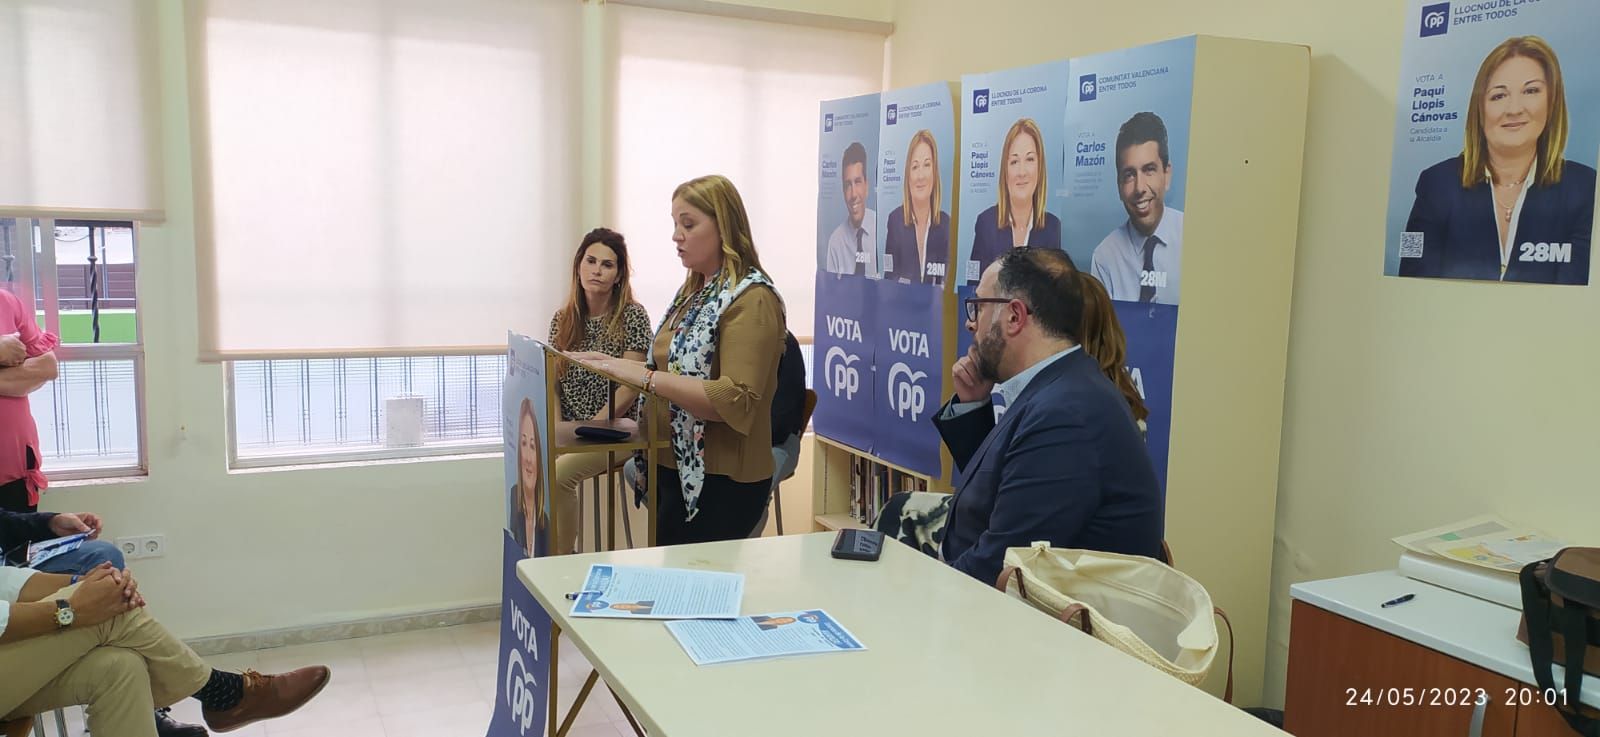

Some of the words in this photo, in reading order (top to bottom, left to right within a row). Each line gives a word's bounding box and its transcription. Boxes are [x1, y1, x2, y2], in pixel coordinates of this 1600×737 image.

[1455, 1, 1497, 15] LLOCNOU
[1454, 14, 1483, 25] ENTRE
[1485, 8, 1518, 20] TODOS
[1098, 72, 1130, 84] COMUNITAT
[1413, 85, 1445, 98] Paqui
[1412, 98, 1445, 111] Llopis
[1411, 112, 1458, 123] Cánovas
[1076, 141, 1106, 153] Carlos
[1075, 154, 1105, 167] Mazón
[1519, 242, 1572, 263] 28M
[926, 262, 945, 277] 28M
[1140, 270, 1167, 288] 28M
[826, 314, 863, 343] VOTA
[889, 327, 930, 359] VOTA
[511, 598, 538, 661] VOTA
